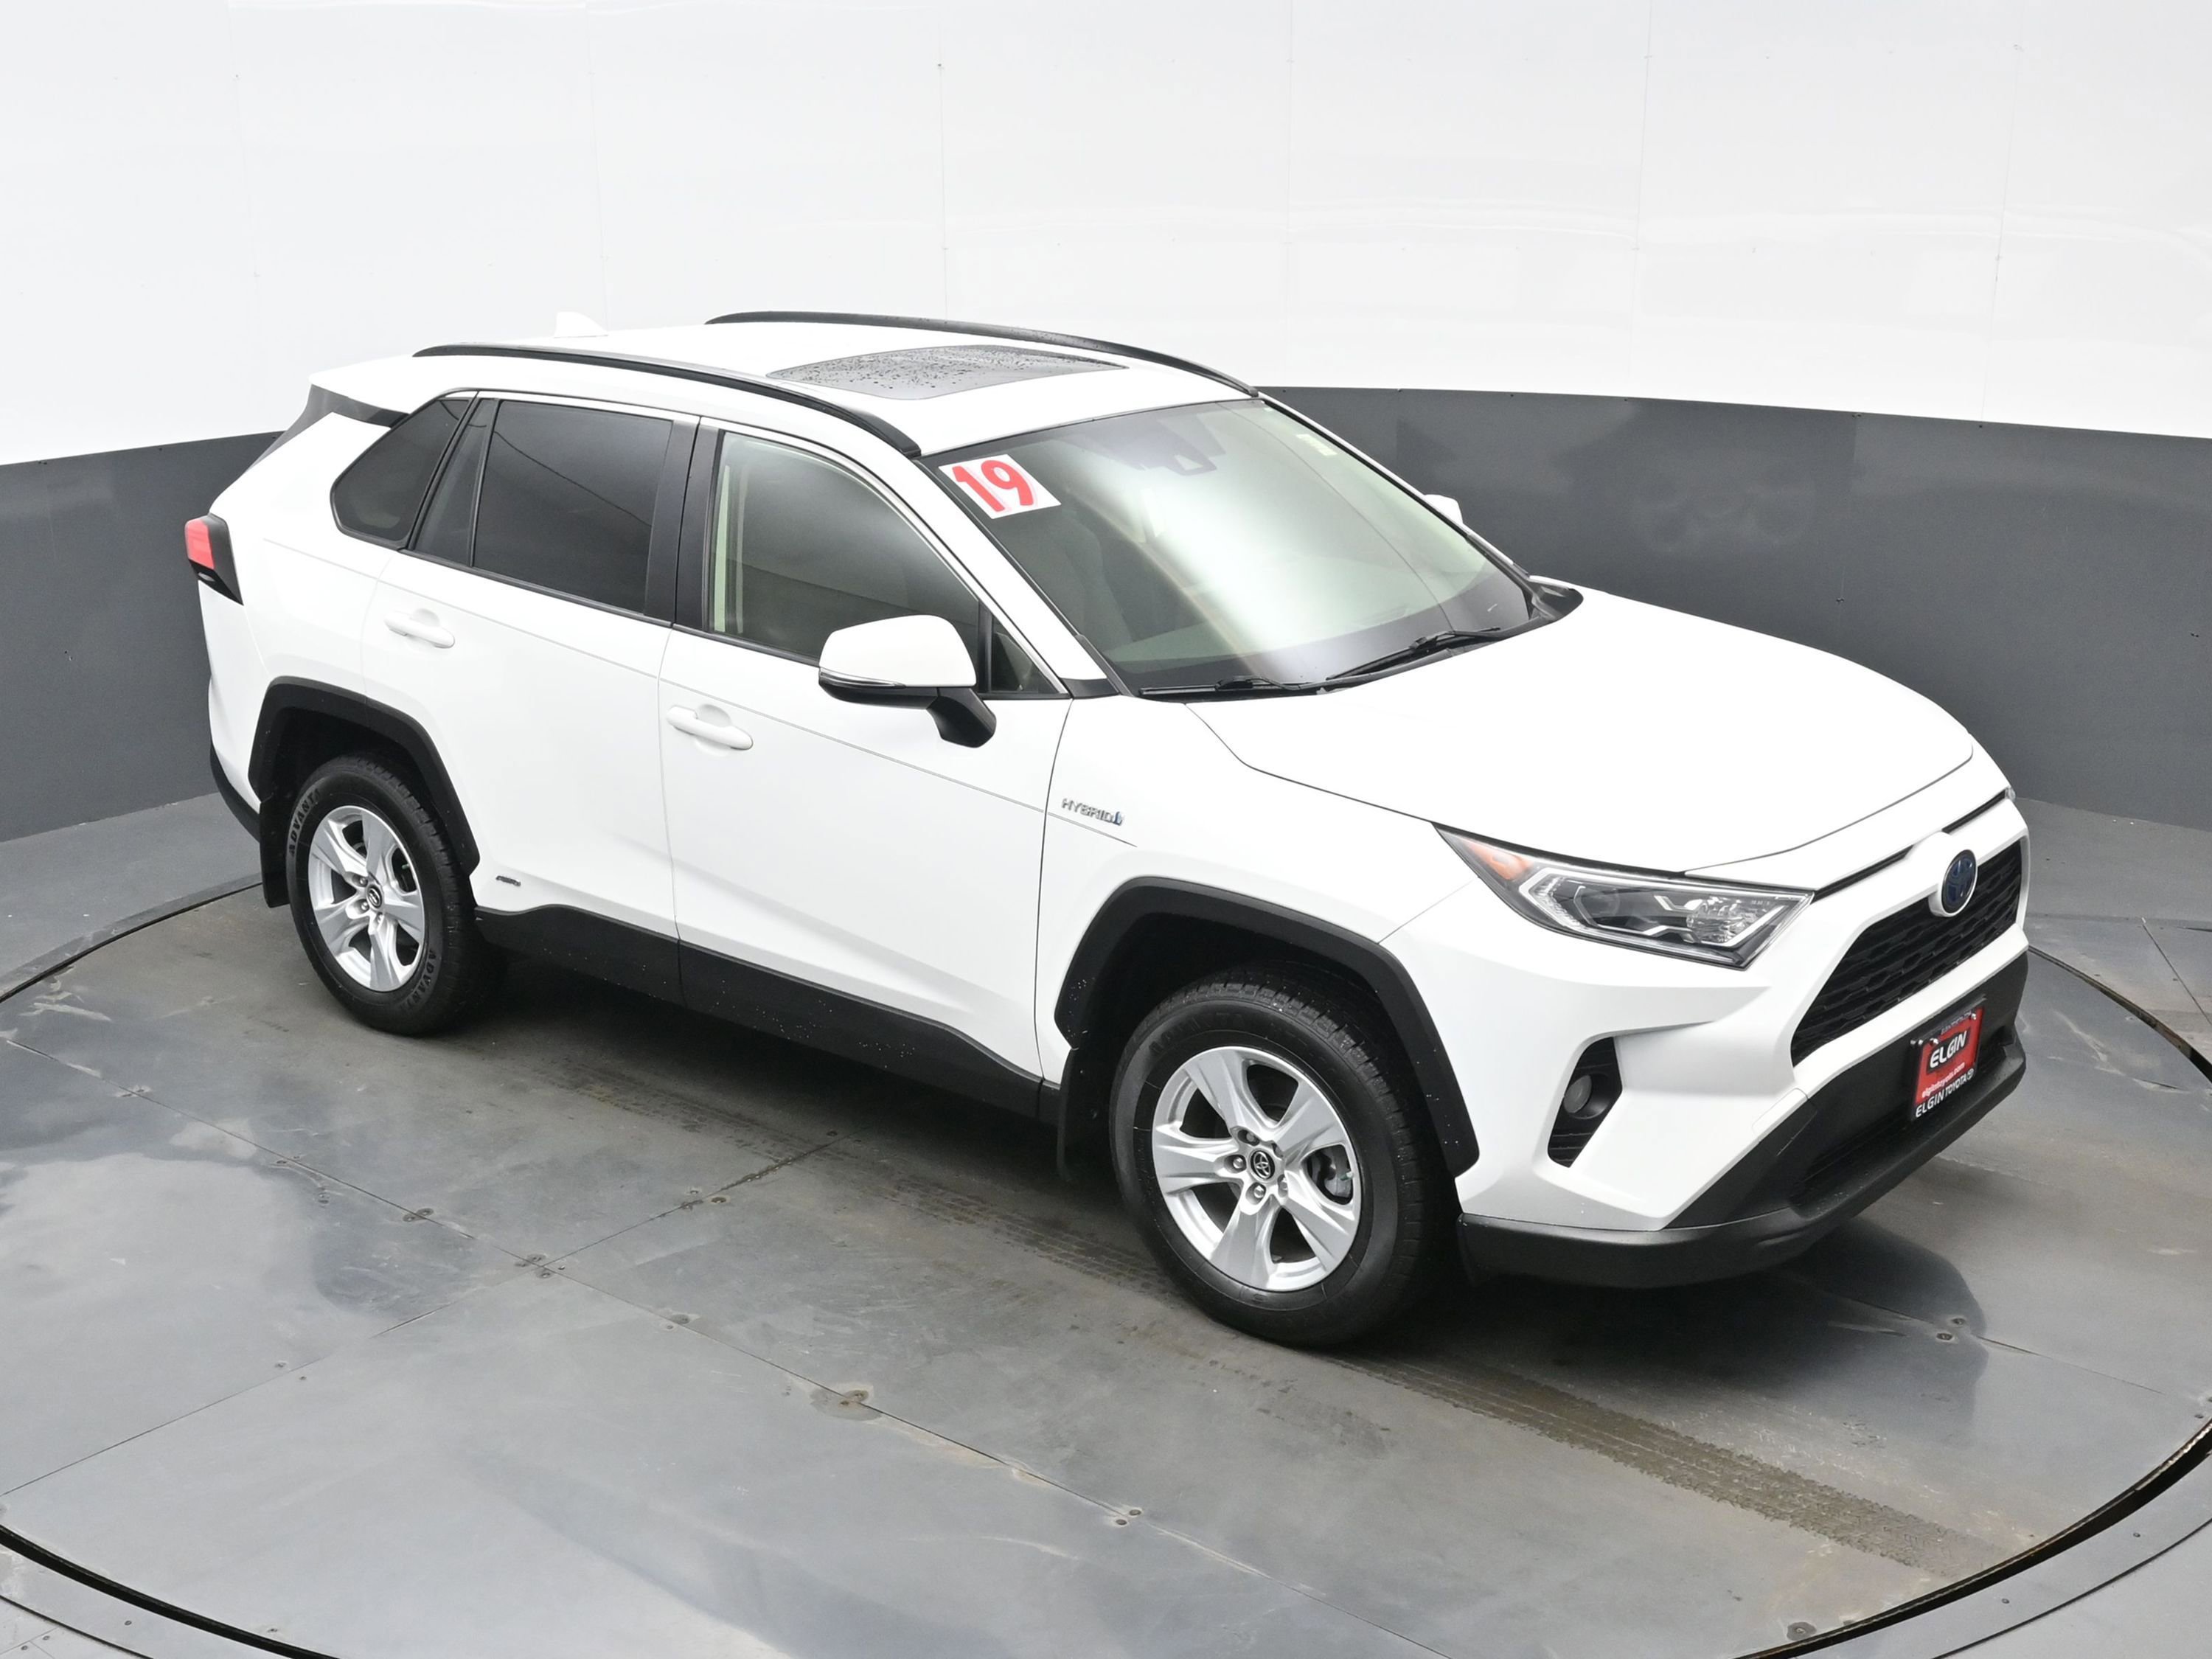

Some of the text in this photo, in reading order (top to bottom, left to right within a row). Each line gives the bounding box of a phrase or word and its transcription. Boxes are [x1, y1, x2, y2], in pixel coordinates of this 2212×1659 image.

[951, 459, 1034, 512] 19
[1061, 798, 1114, 824] HYBRID
[1929, 1030, 1968, 1068] ELGIN
[1915, 1074, 1967, 1118] ELGIN TOYOTA
